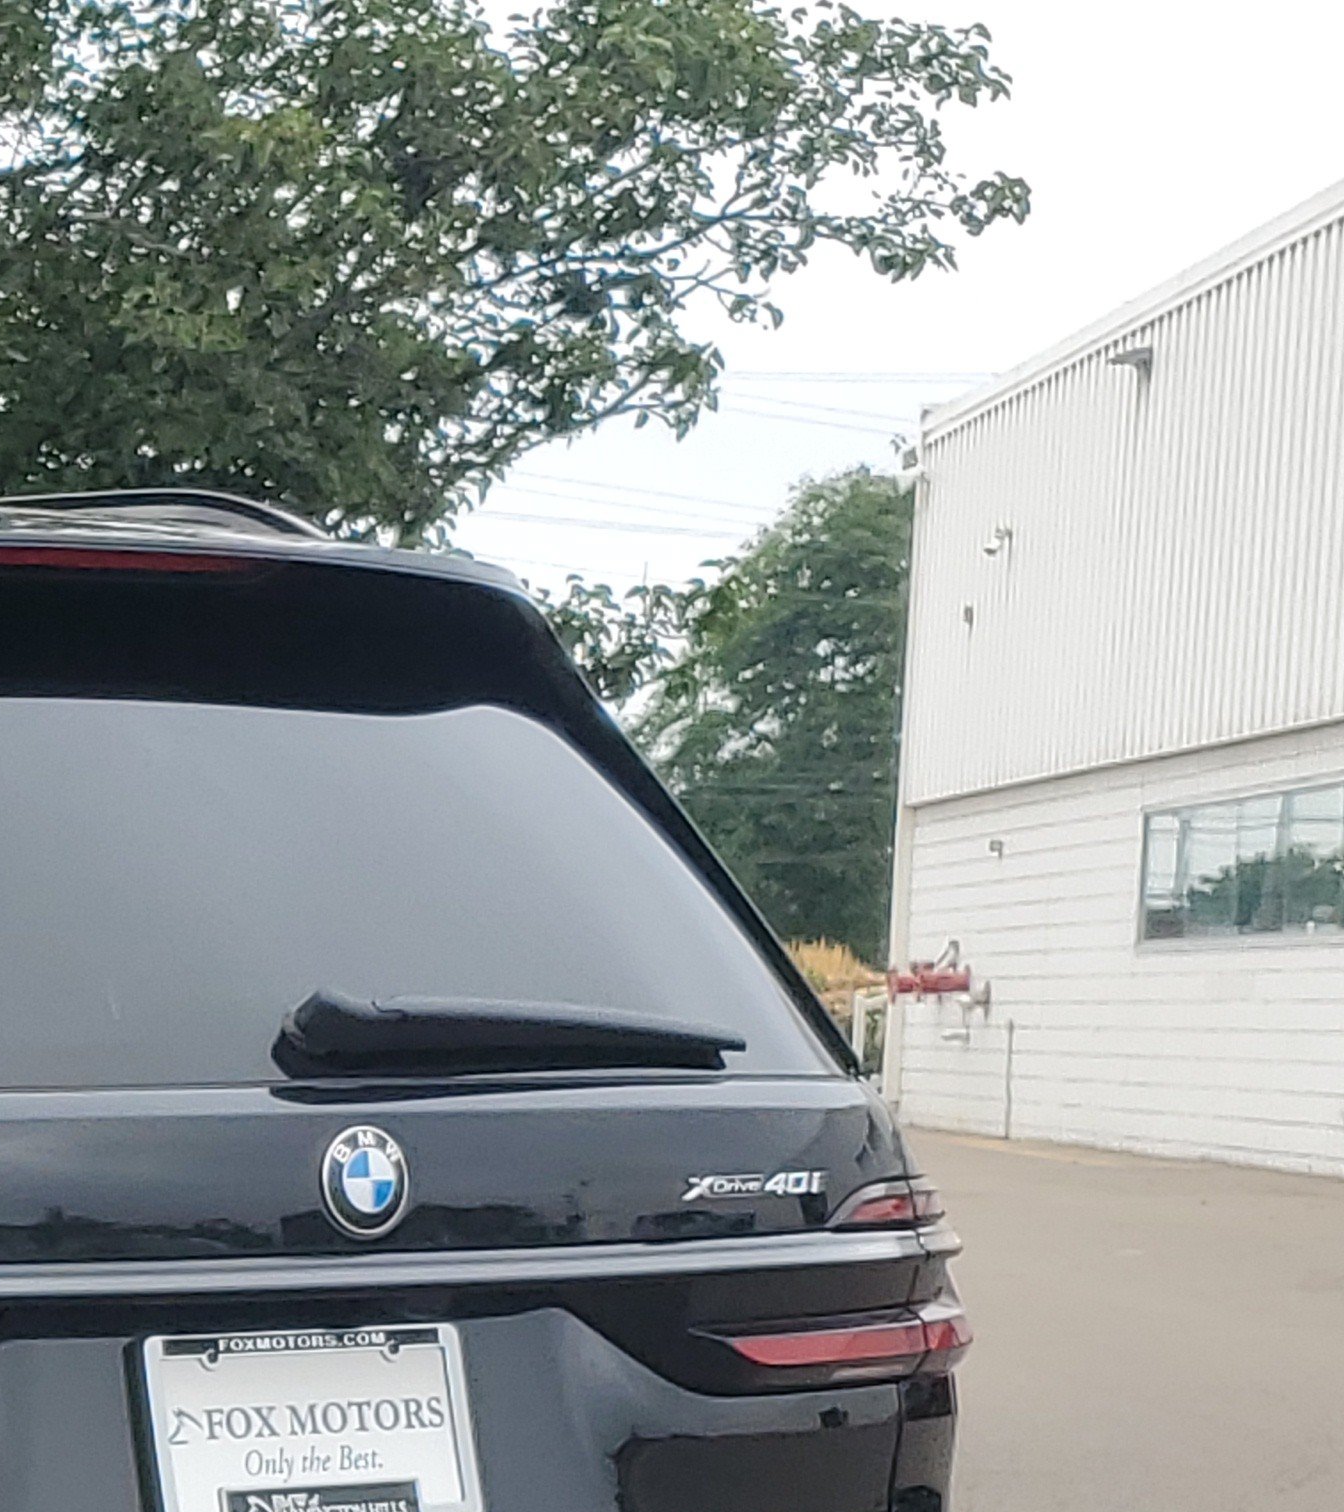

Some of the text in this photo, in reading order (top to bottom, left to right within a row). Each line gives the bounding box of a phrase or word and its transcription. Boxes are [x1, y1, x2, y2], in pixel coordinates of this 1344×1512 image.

[218, 1332, 387, 1352] FOXMOTORS.COM
[204, 1397, 445, 1441] FOX MOTORS
[245, 1445, 384, 1481] Only the Best.
